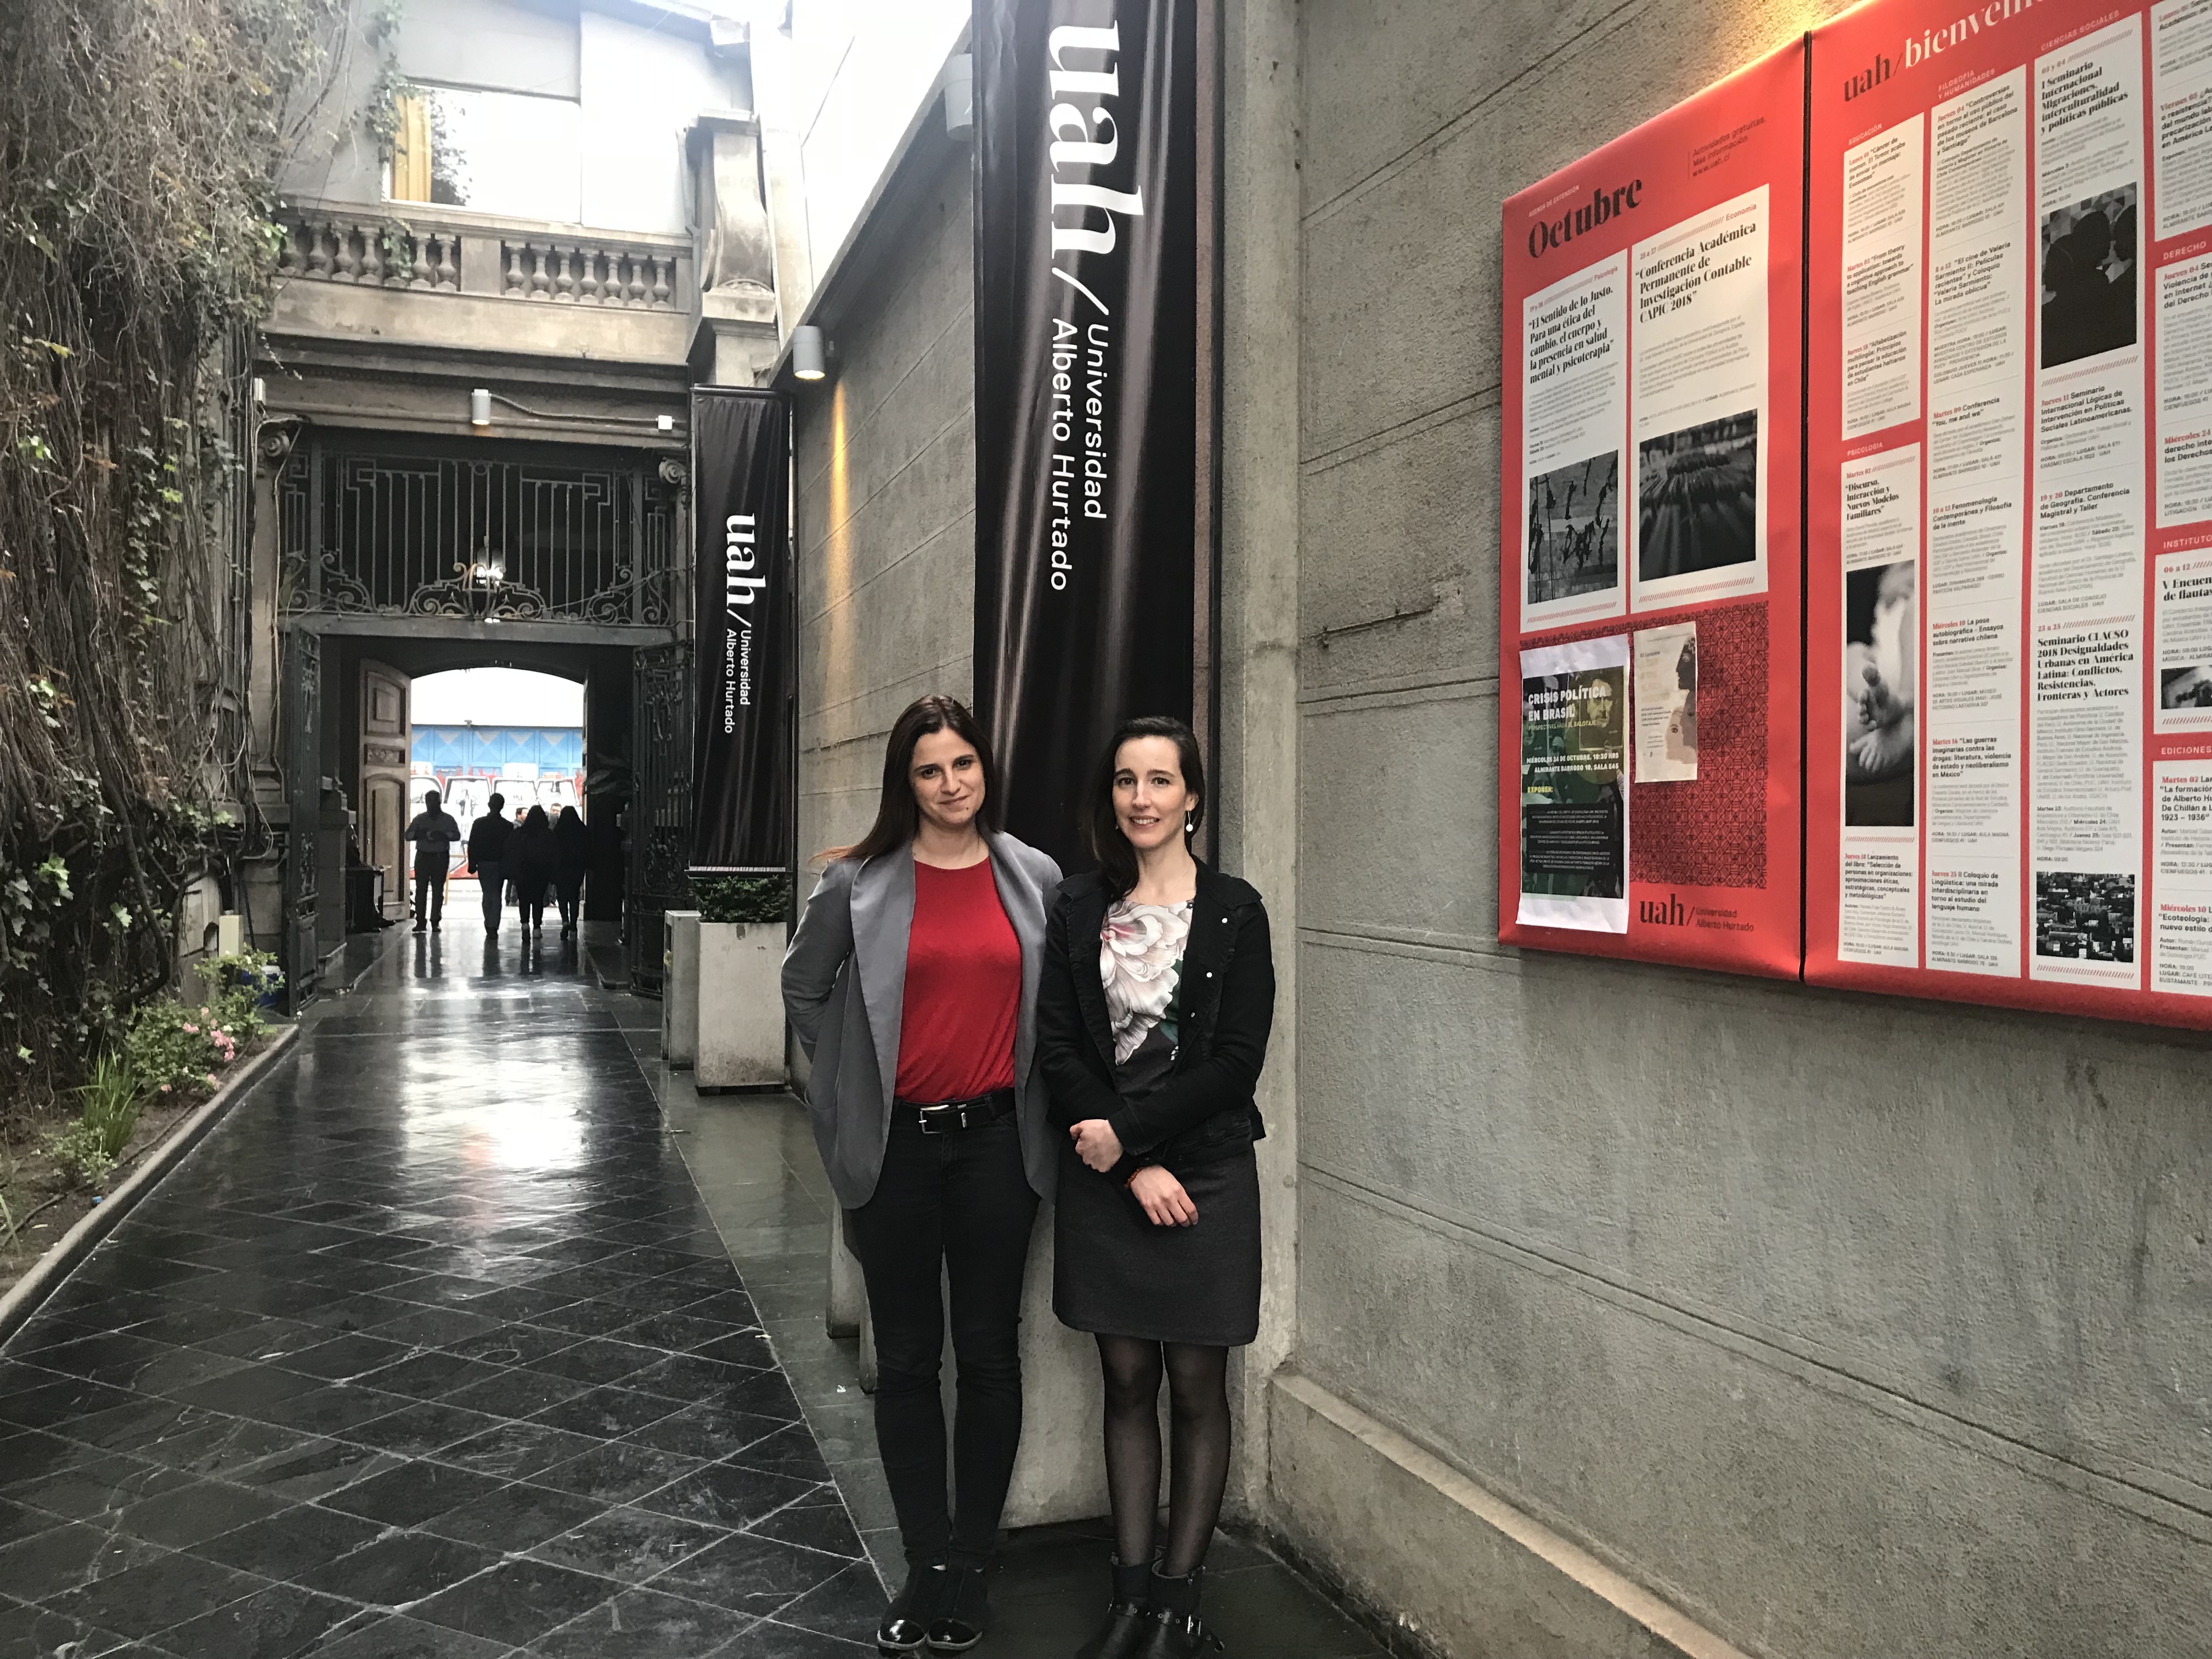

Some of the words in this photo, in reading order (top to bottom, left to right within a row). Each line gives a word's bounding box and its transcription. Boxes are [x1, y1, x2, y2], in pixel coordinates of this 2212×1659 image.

[2041, 31, 2078, 51] CIENCIAS
[2080, 10, 2120, 33] SOCIALES
[1944, 67, 1995, 97] HUMANIDADES
[2041, 81, 2045, 89] I
[2047, 61, 2093, 85] Seminario
[2041, 66, 2102, 100] Internacional
[2041, 127, 2045, 136] y
[2049, 109, 2086, 132] políticas
[2089, 93, 2128, 115] públicas
[1693, 133, 1730, 157] Actividades
[1848, 123, 1882, 145] EDUCACIÓN
[1692, 153, 1730, 177] www.uah.cl
[1529, 179, 1642, 258] Octubre
[1725, 204, 1757, 221] Economía
[1635, 247, 1694, 279] “Conferencia
[1700, 223, 1756, 252] Académica
[2163, 241, 2207, 260] DERECHO
[1640, 263, 1695, 294] Permanente
[1698, 256, 1710, 269] de
[1640, 276, 1701, 309] Investigación
[1703, 255, 1751, 281] Contable
[1528, 317, 1539, 330] “El
[1541, 305, 1567, 324] Sentido
[1568, 299, 1578, 312] de
[1580, 295, 1588, 307] lo
[1590, 286, 1613, 302] Justo.
[1640, 303, 1665, 323] CAPIC
[1671, 290, 1697, 311] 2018”
[1530, 330, 1546, 344] Para
[1548, 323, 1561, 336] una
[1562, 314, 1581, 328] ética
[1582, 304, 1595, 319] del
[1559, 331, 1566, 343] el
[1567, 322, 1595, 340] cuerpo
[1596, 319, 1601, 330] y
[1530, 360, 1537, 370] la
[1538, 344, 1572, 370] presencia
[1574, 340, 1583, 351] en
[1585, 327, 1607, 346] salud
[1530, 363, 1555, 384] mental
[1556, 364, 1560, 375] y
[1562, 338, 1613, 373] psicoterapia”
[1053, 319, 1077, 441] Alberto
[2041, 397, 2062, 407] Jueves
[2070, 386, 2104, 399] Seminario
[2041, 398, 2084, 415] Internacional
[2086, 393, 2112, 404] Lógicas
[1085, 324, 1108, 518] Universidad
[2041, 409, 2083, 424] Intervención
[2041, 422, 2068, 432] Sociales
[2070, 407, 2132, 426] Latinoamericanas.
[1846, 470, 1864, 479] Martes
[1847, 487, 1884, 501] Interacción
[2064, 483, 2113, 497] Departamento
[2087, 488, 2130, 501] Conferencia
[1847, 501, 1870, 510] Nuevos
[1872, 493, 1899, 505] Modelos
[1847, 505, 1884, 520] Familiares”
[1951, 496, 1997, 510] Fenomenología
[2040, 507, 2072, 518] Magistral
[1051, 455, 1074, 590] Hurtado
[1933, 509, 1978, 522] Contemporánea
[2164, 534, 2212, 549] INSTITUTO
[2038, 634, 2085, 646] Seminario
[2087, 629, 2129, 641] CLACSO
[726, 629, 736, 676] Alberto
[2038, 648, 2057, 658] 2018
[2060, 641, 2129, 656] Desigualdades
[2038, 659, 2075, 668] Urbanas
[2094, 652, 2133, 663] América
[740, 630, 751, 704] Universidad
[2038, 670, 2069, 679] Latina:
[1528, 691, 1559, 705] CRISIS
[1560, 685, 1606, 701] POLÍTICA
[2037, 692, 2081, 701] Fronteras
[2083, 691, 2088, 700] y
[2094, 689, 2129, 697] Actores
[725, 681, 735, 733] Hurtado
[1528, 710, 1540, 721] EN
[1543, 706, 1575, 720] BRASIL
[1526, 755, 1553, 764] MIÉRCOLES
[2162, 746, 2211, 755] EDICIONES
[1696, 907, 1737, 918] Universidad
[1697, 919, 1721, 929] Alberto
[1723, 922, 1754, 932] Hurtado
